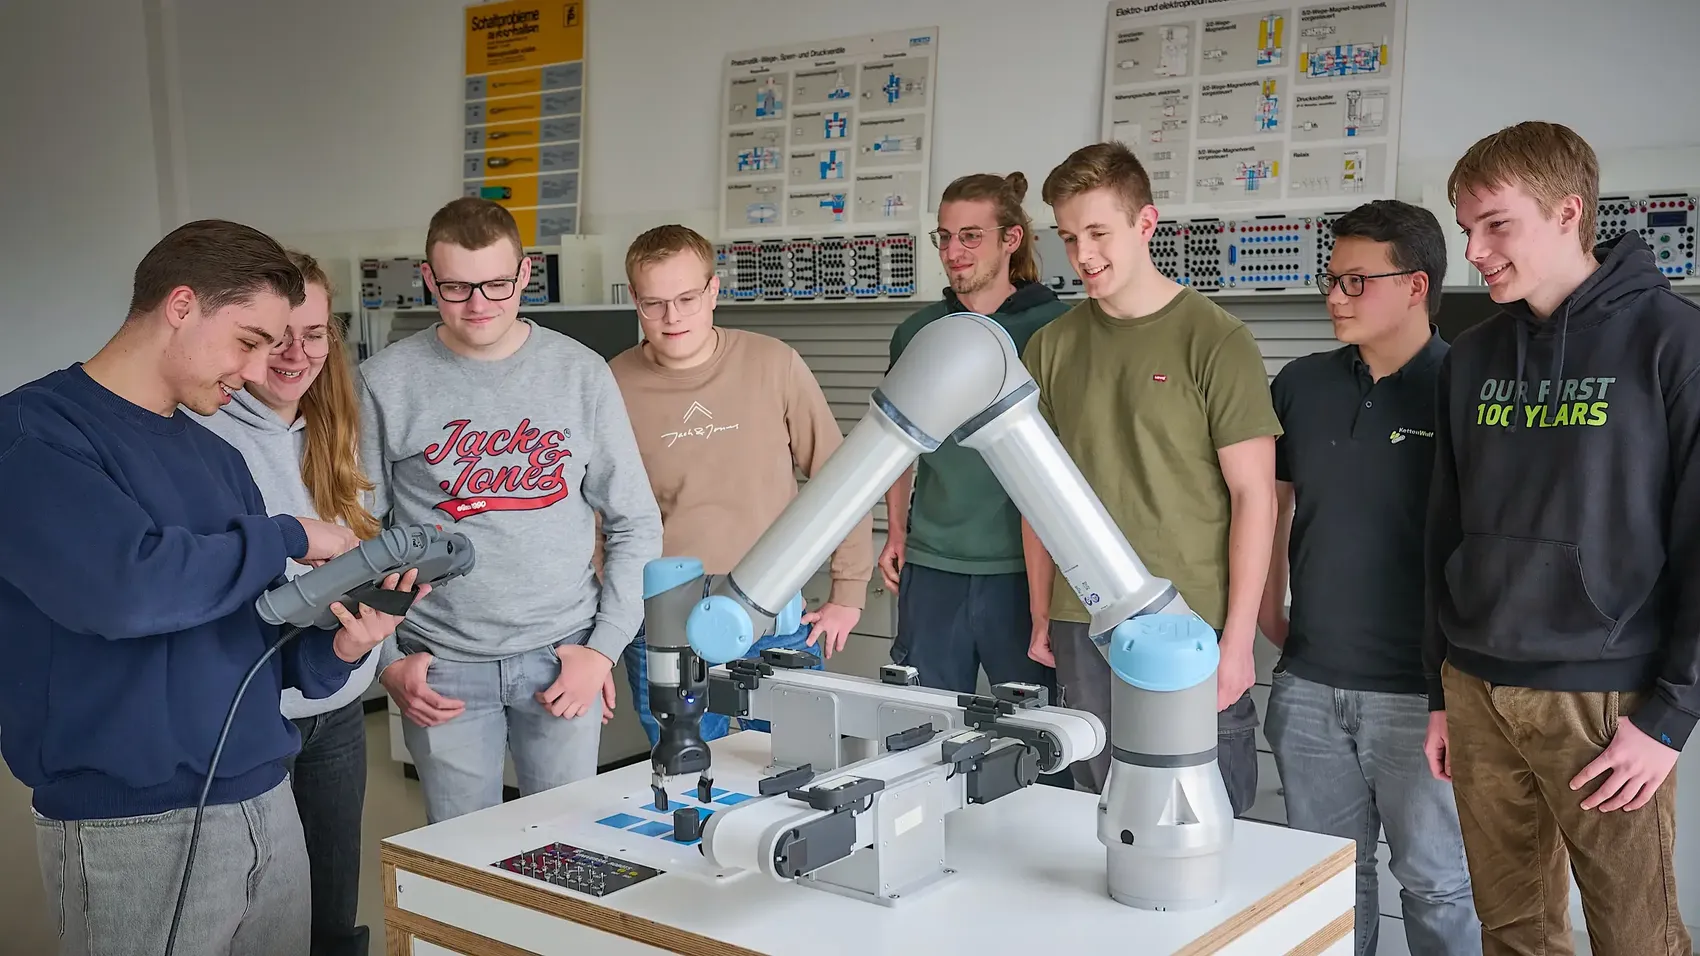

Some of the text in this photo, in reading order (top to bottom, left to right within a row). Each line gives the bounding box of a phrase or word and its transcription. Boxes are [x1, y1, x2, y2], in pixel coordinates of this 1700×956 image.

[1144, 3, 1158, 13] und
[1480, 378, 1529, 403] OUR
[424, 418, 572, 467] Jack &
[439, 456, 565, 497] Jones
